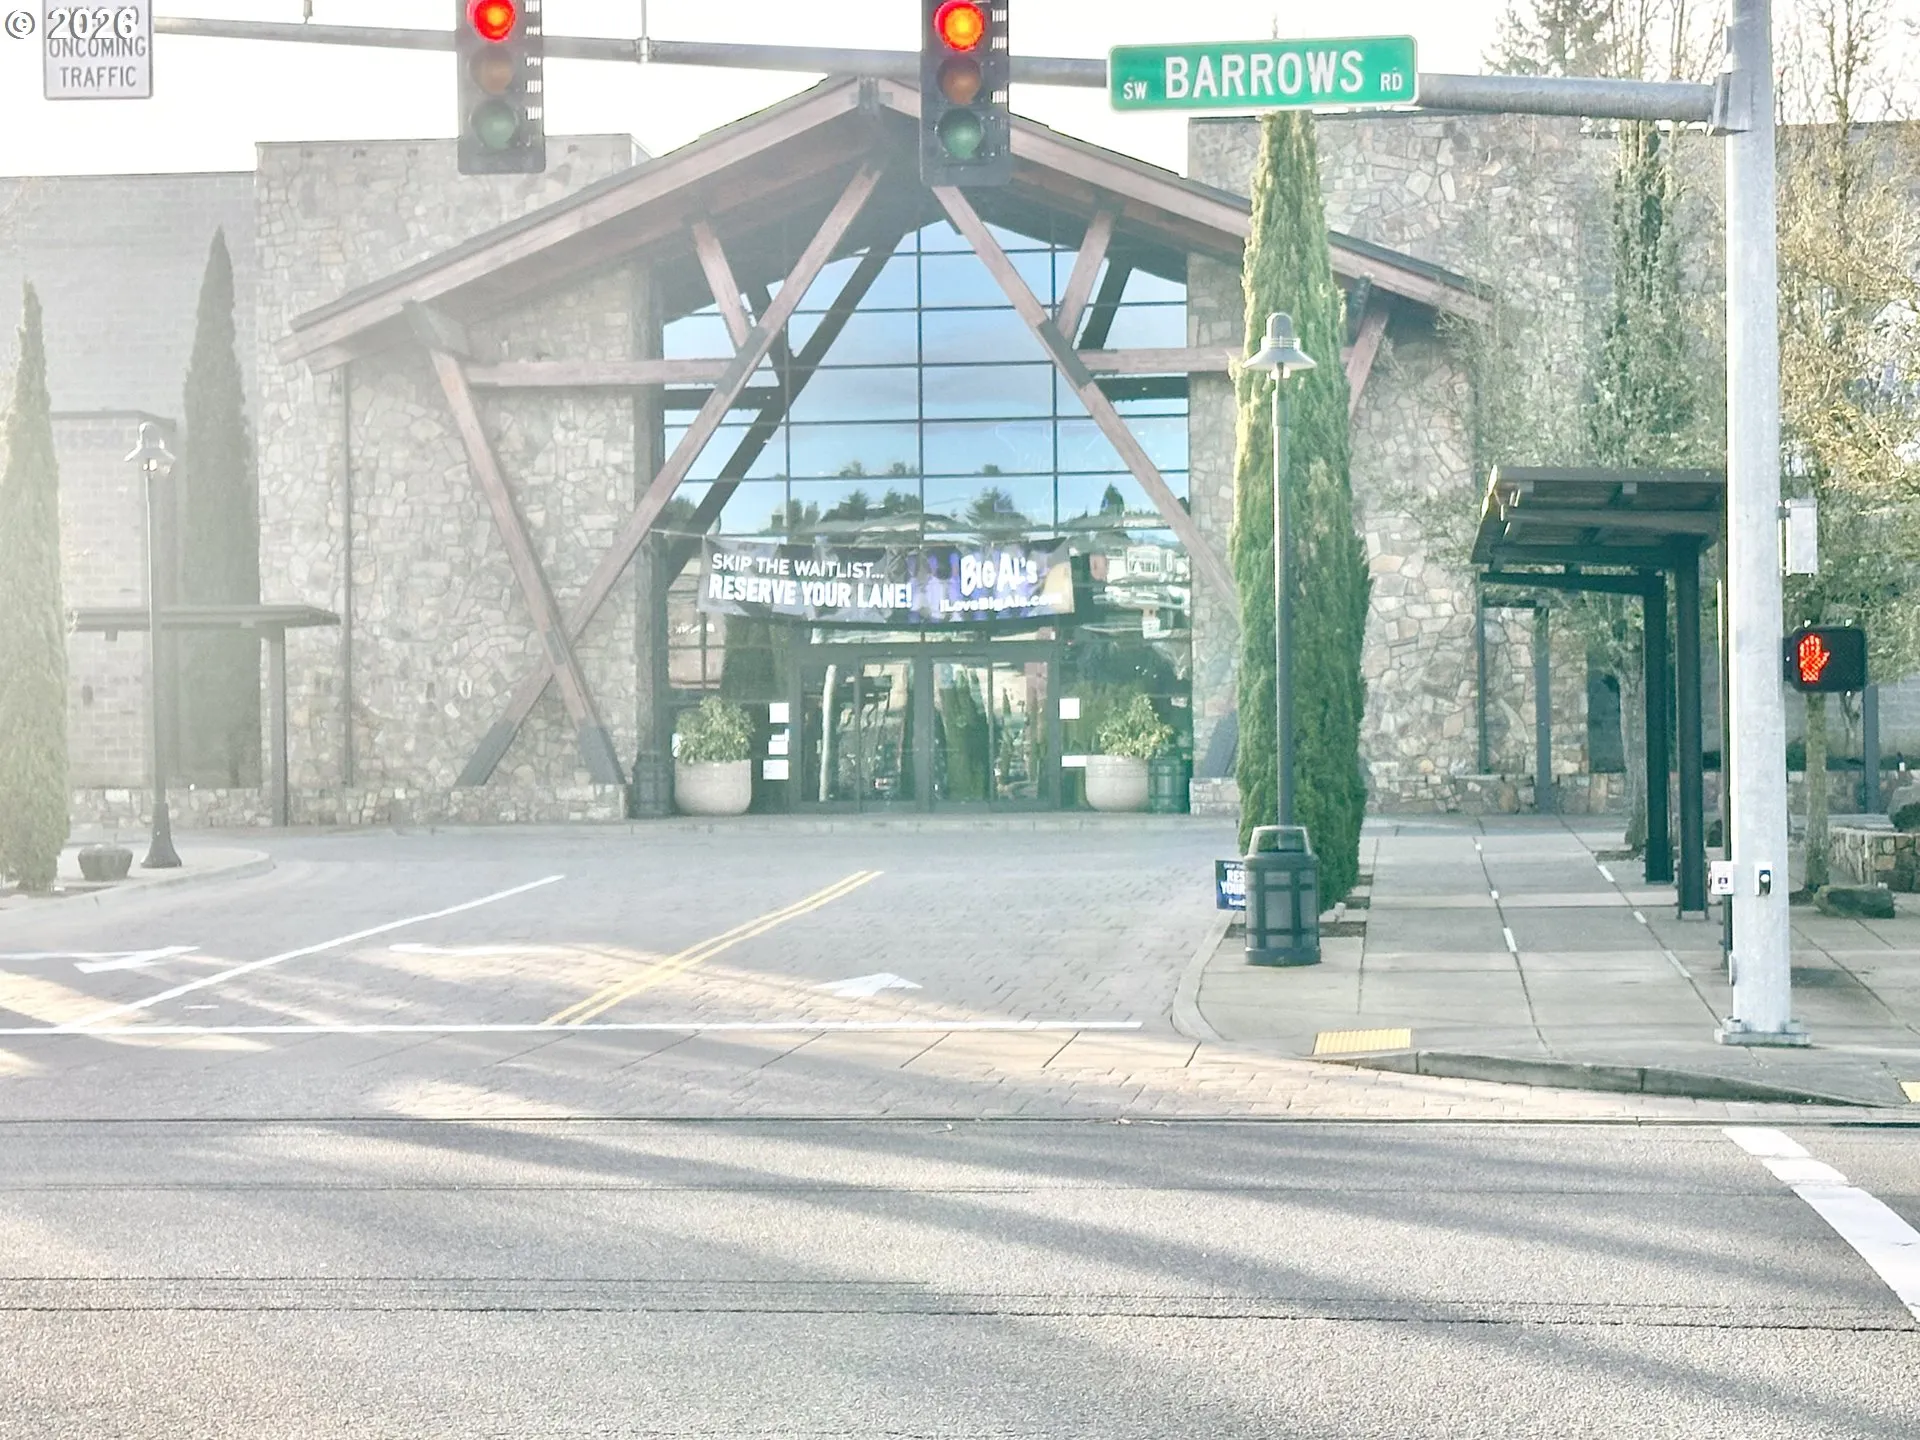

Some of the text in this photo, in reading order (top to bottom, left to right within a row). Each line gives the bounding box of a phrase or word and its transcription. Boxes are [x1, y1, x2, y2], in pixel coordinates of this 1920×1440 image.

[49, 36, 146, 58] ONCOMING
[60, 66, 136, 88] TRAFFIC
[1123, 50, 1403, 100] SW BARROWS RD
[711, 553, 885, 579] SKIP THE WAITLIST...
[708, 573, 913, 609] RESERVE YOUR LANE!
